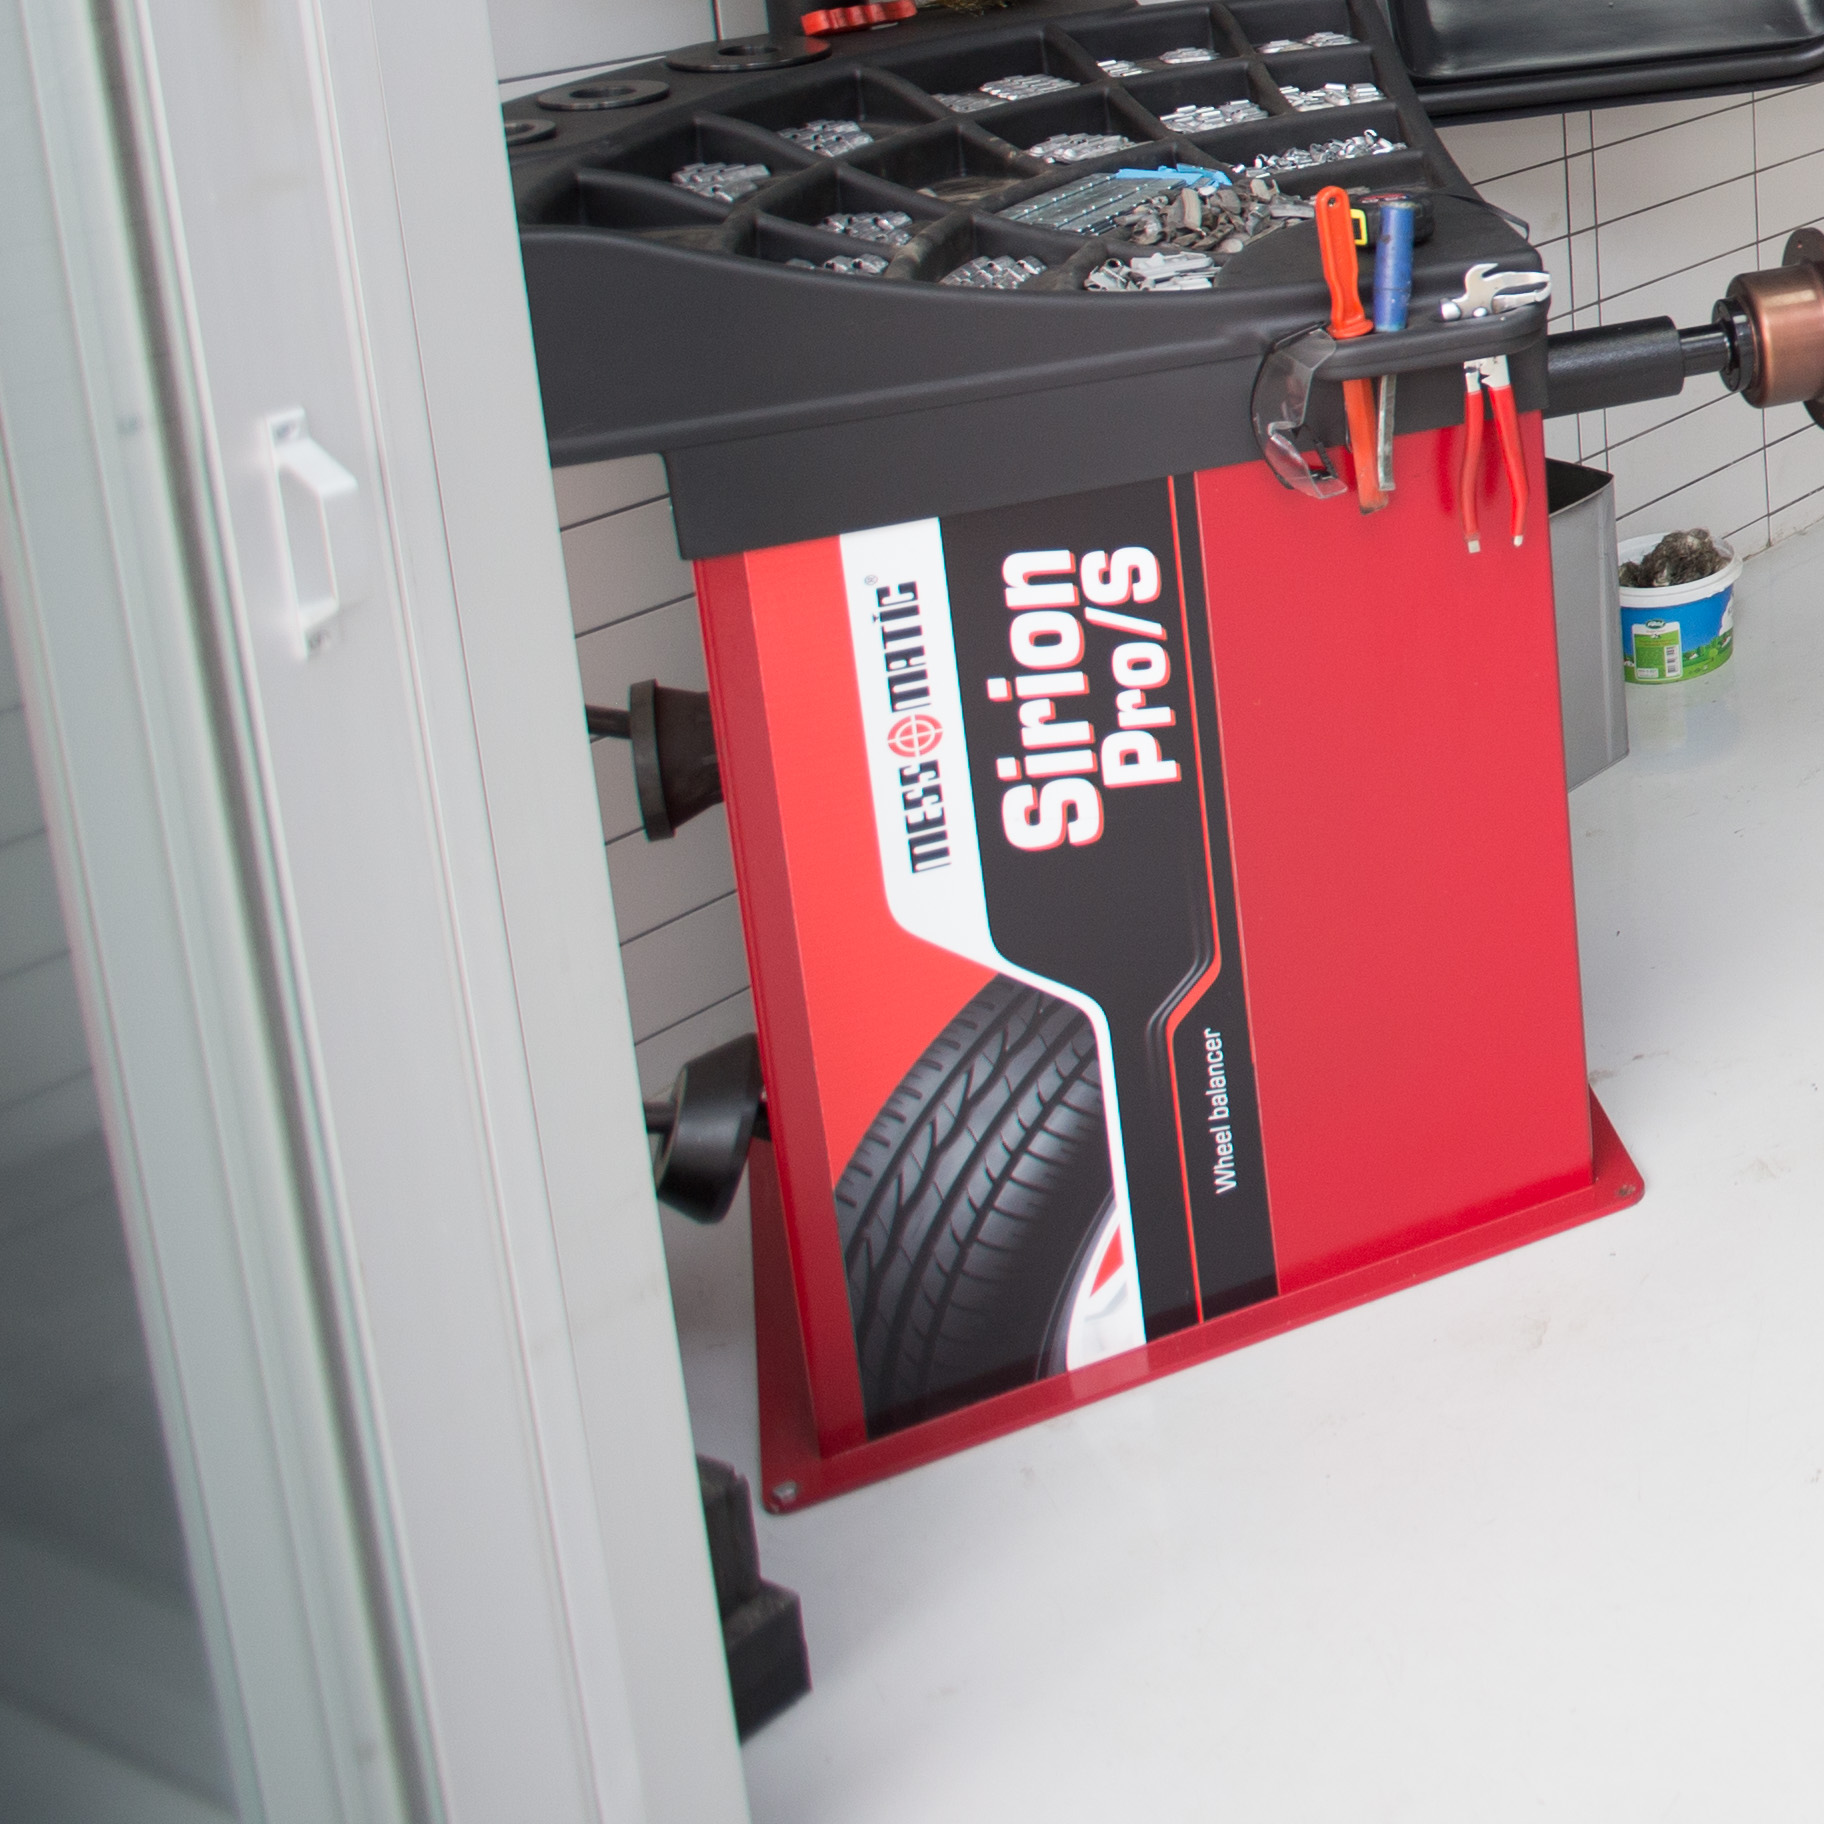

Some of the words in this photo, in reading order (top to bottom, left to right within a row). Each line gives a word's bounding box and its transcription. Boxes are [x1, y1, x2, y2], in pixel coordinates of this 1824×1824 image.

[986, 549, 1106, 852] Sirion
[1203, 1027, 1231, 1121] balancer
[1208, 1125, 1238, 1195] Wheel
